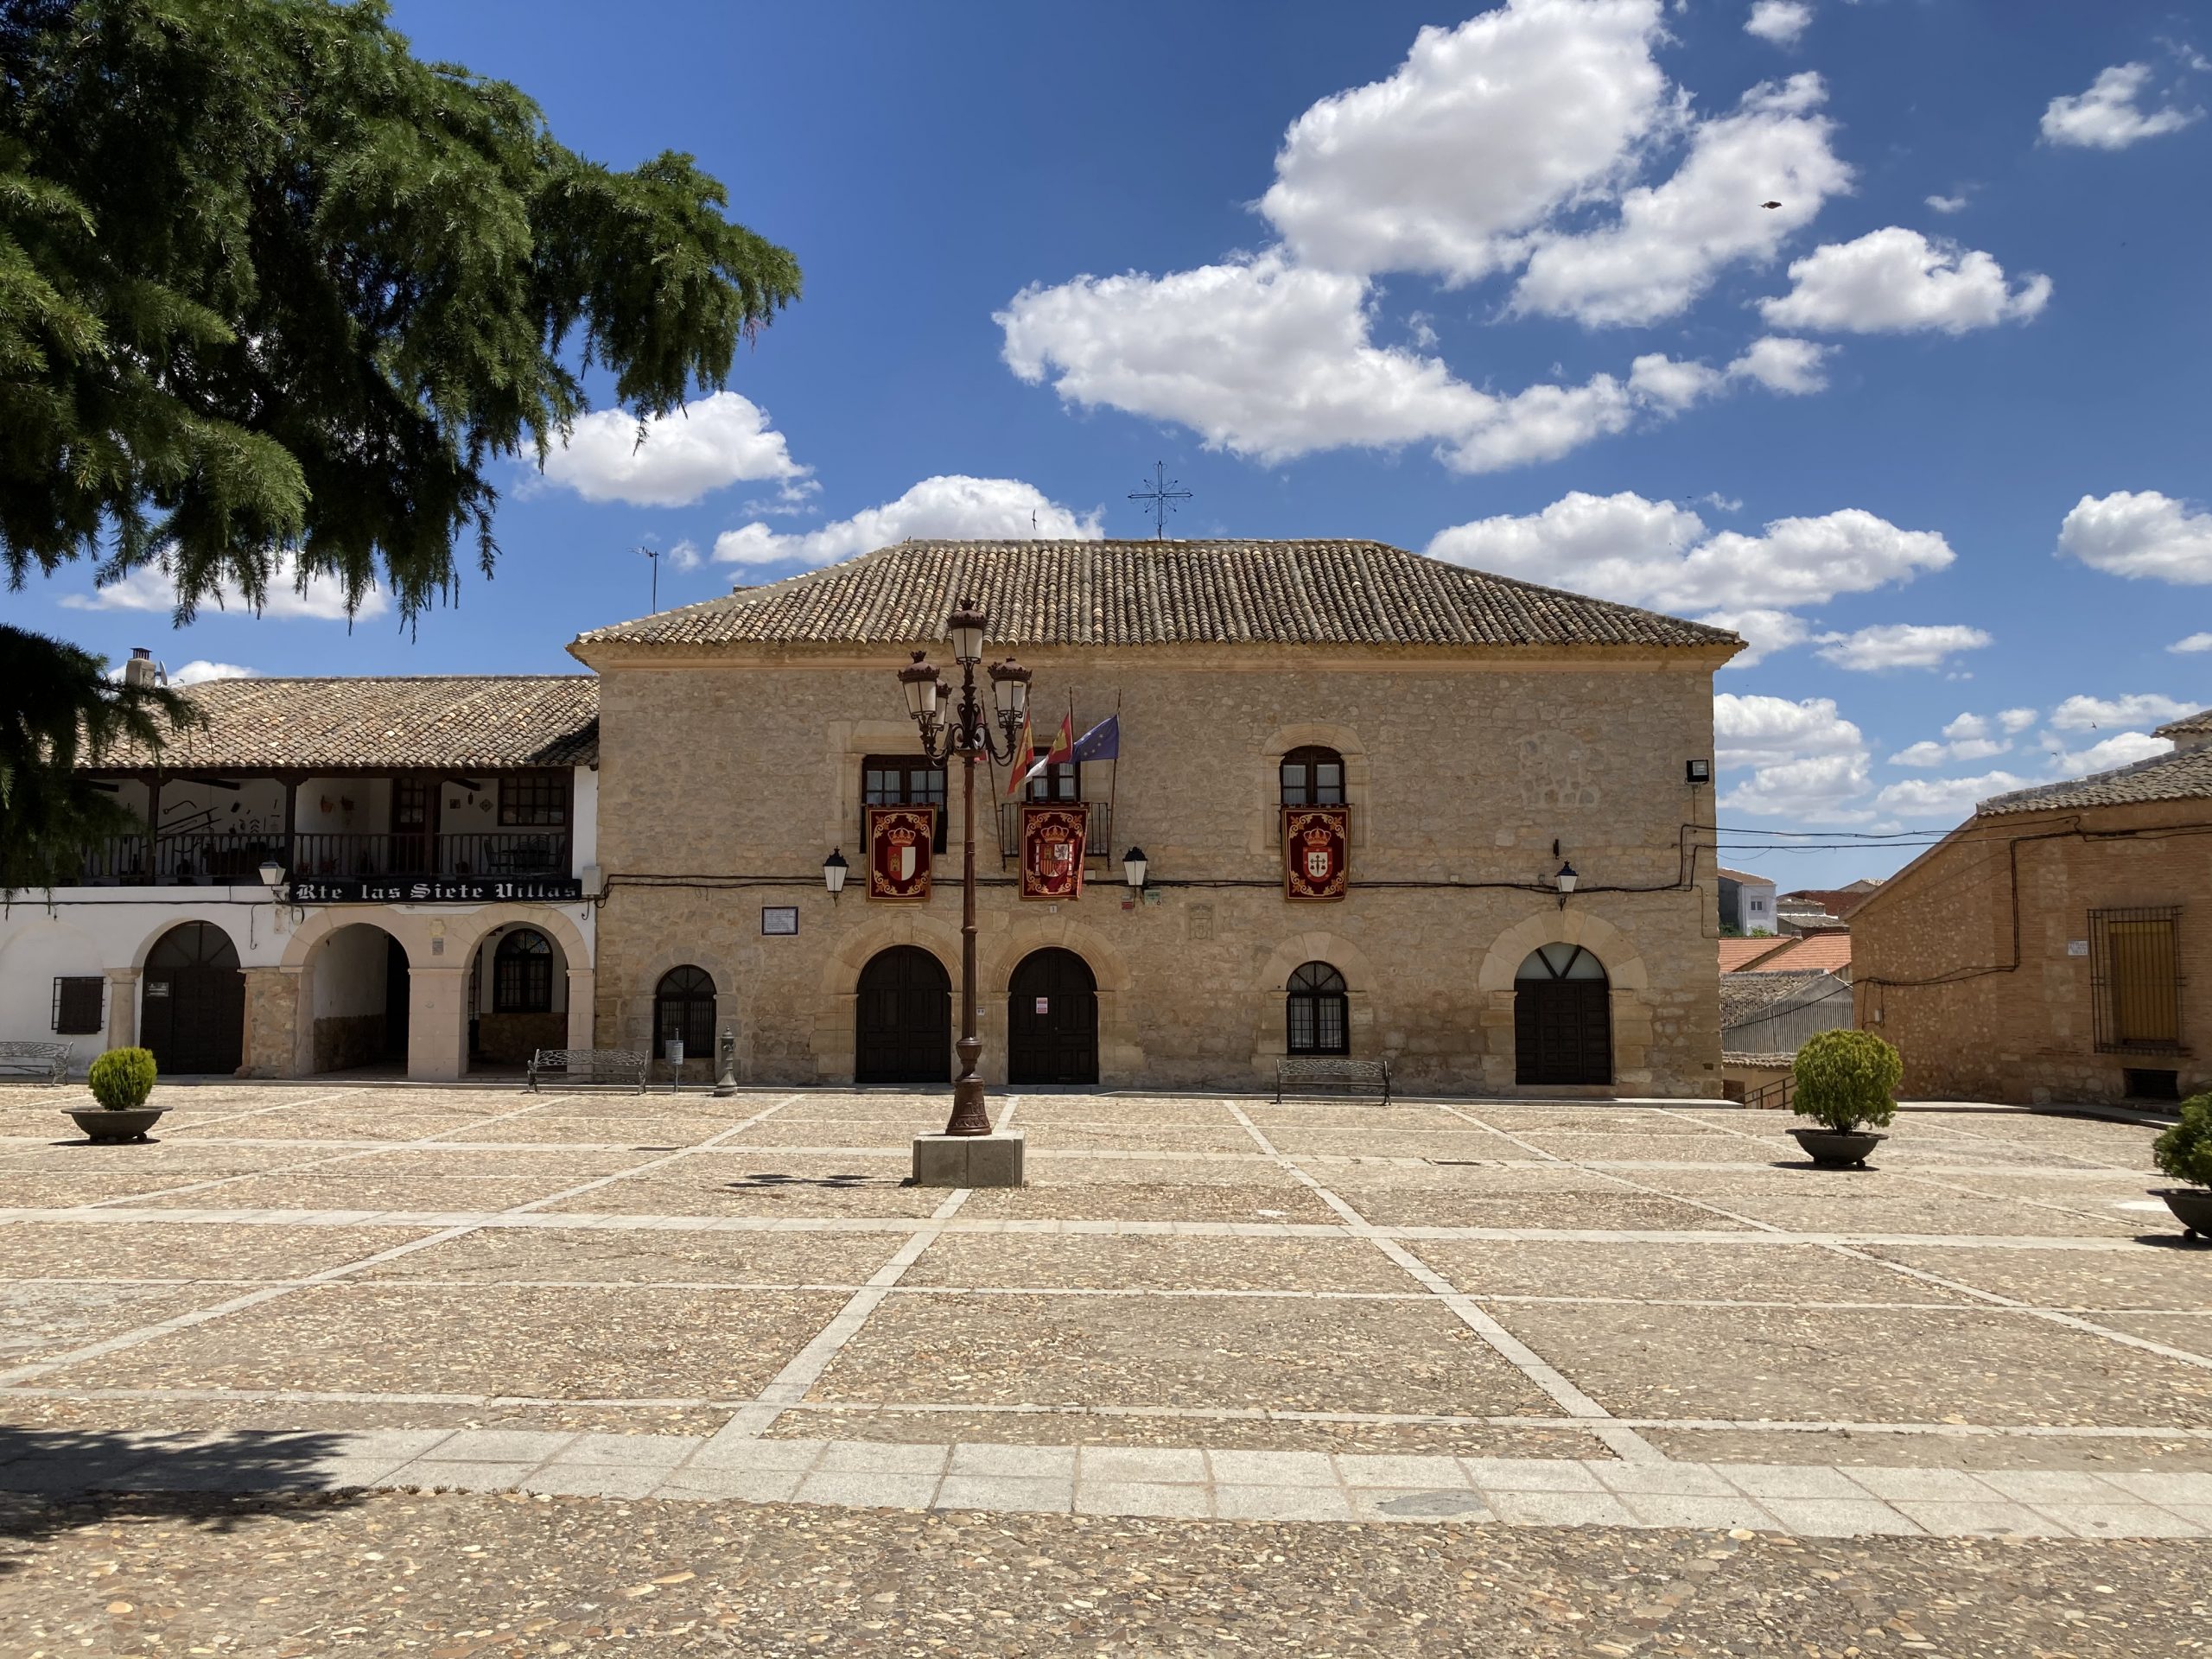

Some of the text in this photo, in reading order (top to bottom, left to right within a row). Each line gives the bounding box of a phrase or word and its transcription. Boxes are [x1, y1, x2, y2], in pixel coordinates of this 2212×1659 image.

[296, 883, 575, 899] Rte las Siete Villas
